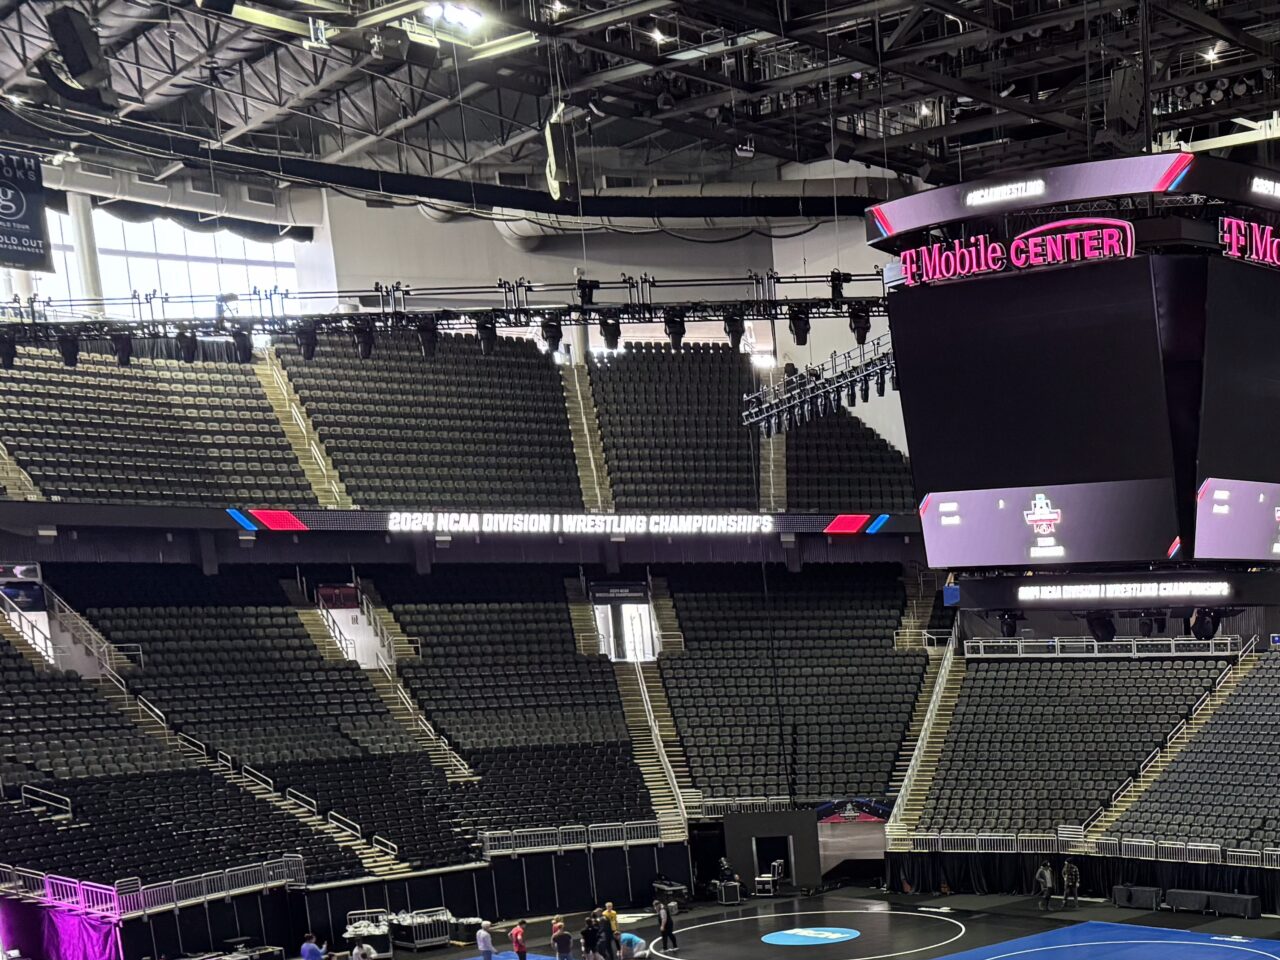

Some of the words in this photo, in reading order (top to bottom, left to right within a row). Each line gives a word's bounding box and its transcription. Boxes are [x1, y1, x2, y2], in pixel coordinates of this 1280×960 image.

[22, 237, 43, 249] OUT
[1010, 228, 1121, 268] CENTER
[388, 512, 434, 531] 2024
[436, 513, 480, 532] NCAA
[482, 514, 551, 532] DIVISION
[562, 515, 646, 533] WRESTLING
[648, 515, 774, 533] CHAMPIONSHIPS
